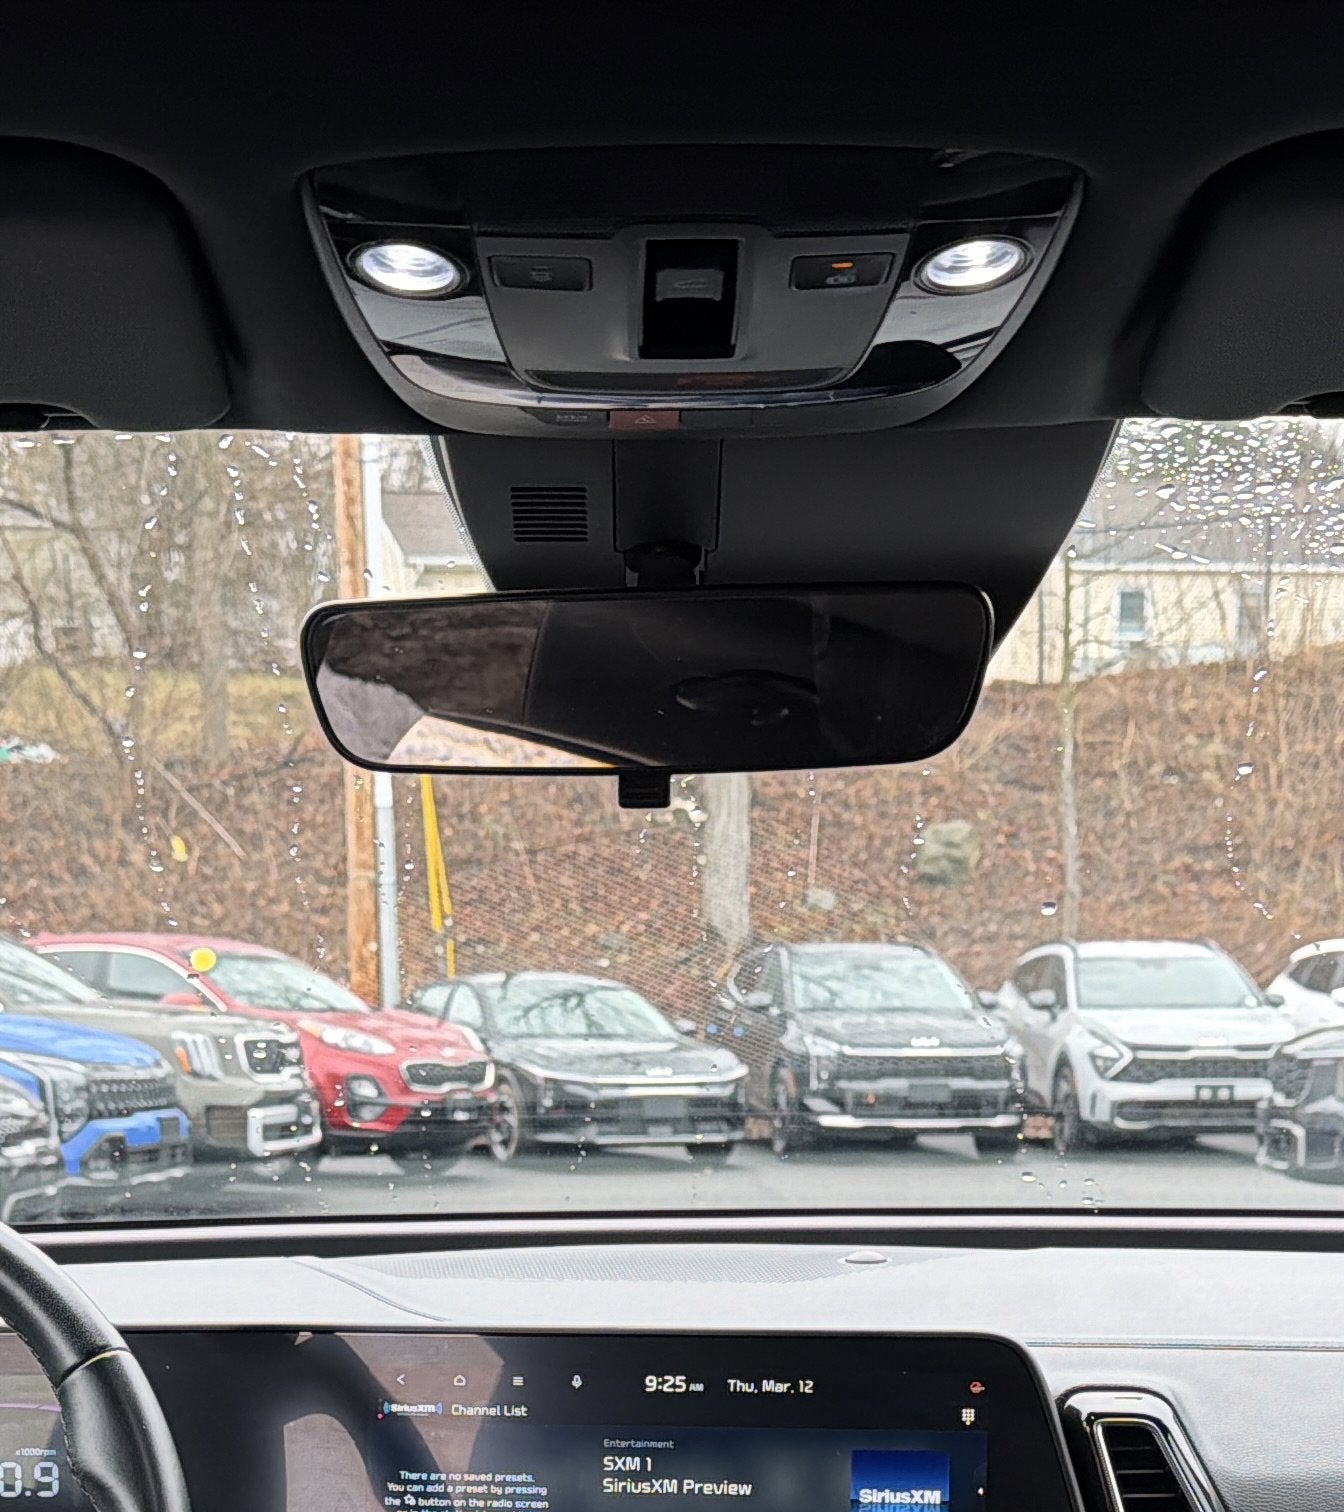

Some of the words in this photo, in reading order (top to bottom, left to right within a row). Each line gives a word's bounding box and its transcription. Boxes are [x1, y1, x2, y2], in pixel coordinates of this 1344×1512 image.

[644, 1375, 687, 1392] 9:25
[689, 1383, 704, 1392] AM
[762, 1379, 795, 1394] Mar.
[799, 1379, 814, 1394] 12
[451, 1404, 500, 1416] Channel
[504, 1404, 528, 1417] List
[603, 1438, 674, 1449] Entertainment
[603, 1456, 641, 1471] SXM
[646, 1457, 652, 1471] 1
[399, 1470, 427, 1480] There
[430, 1472, 446, 1481] are
[449, 1473, 461, 1481] no
[463, 1471, 492, 1482] saved
[495, 1473, 535, 1483] presets.
[387, 1482, 404, 1492] You
[407, 1484, 424, 1492] can
[426, 1483, 444, 1493] add
[447, 1485, 453, 1493] a
[456, 1484, 488, 1495] preset
[491, 1483, 502, 1495] by
[505, 1485, 548, 1496] pressing
[603, 1478, 677, 1494] SiriusXM
[683, 1479, 752, 1495] Preview
[384, 1497, 401, 1506] the
[418, 1497, 452, 1507] button
[455, 1499, 466, 1507] on
[468, 1498, 484, 1507] the
[487, 1498, 513, 1508] radio
[515, 1500, 549, 1508] screen
[858, 1489, 942, 1504] SiriusXM
